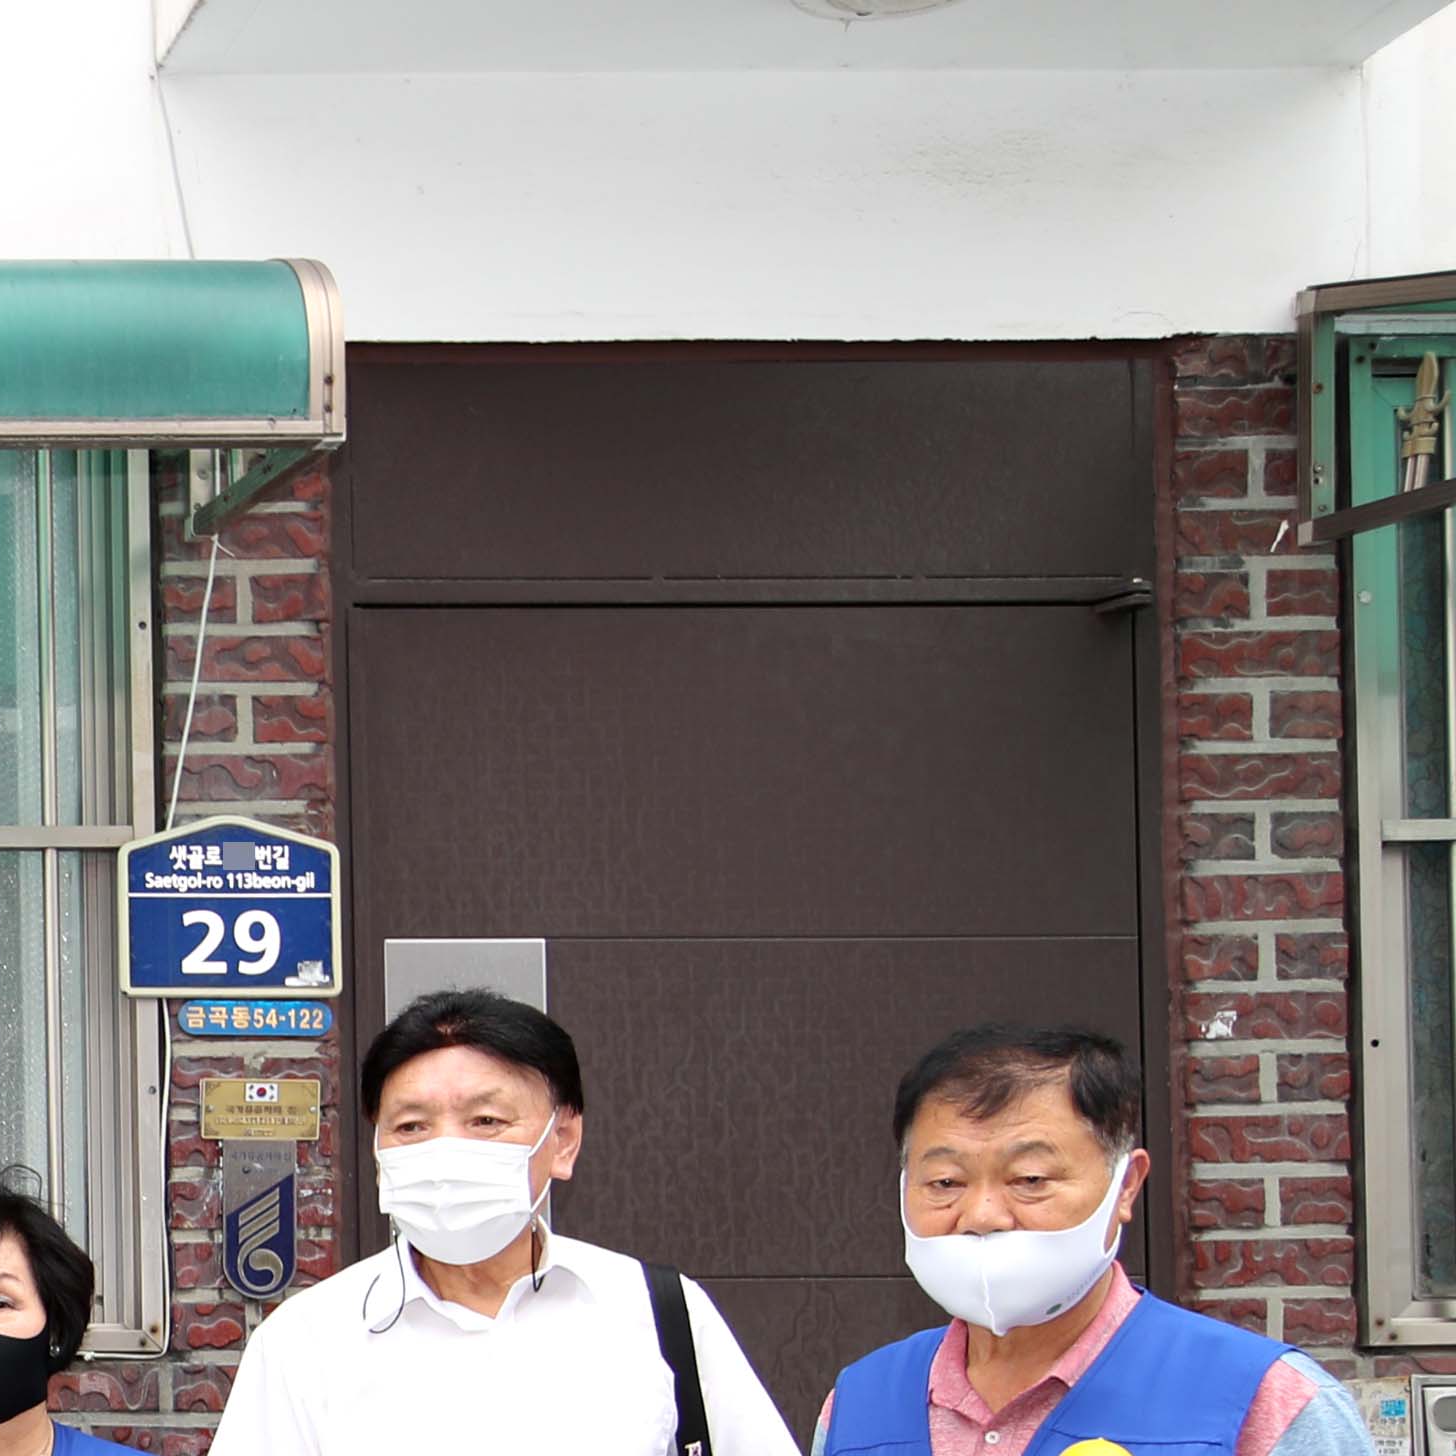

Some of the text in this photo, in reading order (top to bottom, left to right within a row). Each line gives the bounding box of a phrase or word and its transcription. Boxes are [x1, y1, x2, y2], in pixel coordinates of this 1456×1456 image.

[169, 844, 289, 870] 샛골로번길
[145, 871, 315, 892] Saetgol-ro 113beon-gil
[181, 909, 281, 975] 29
